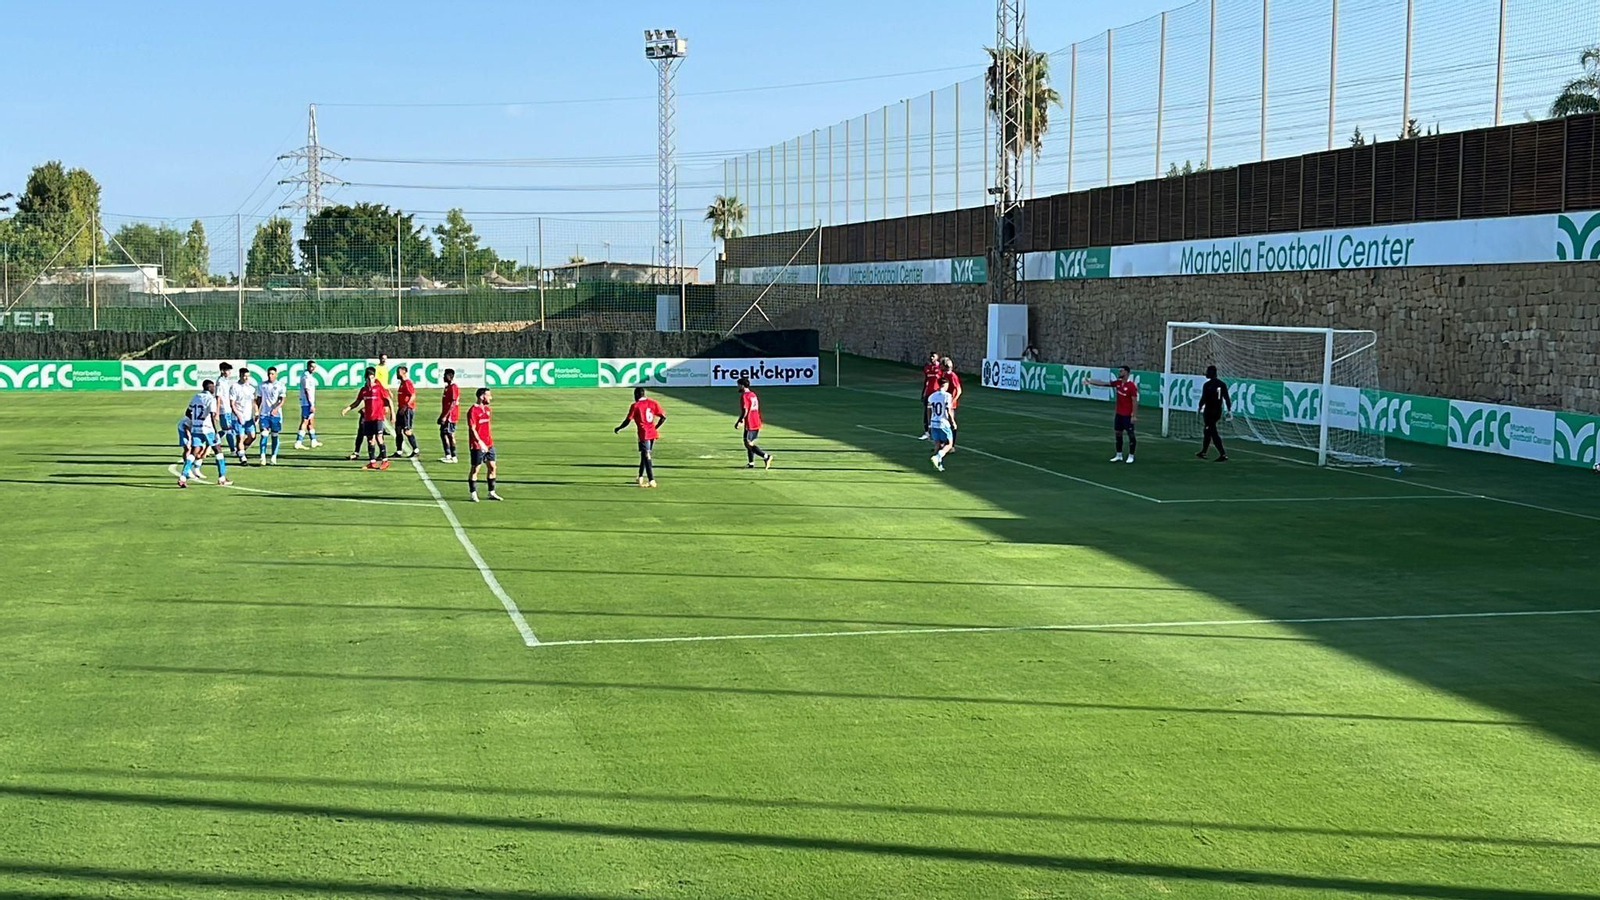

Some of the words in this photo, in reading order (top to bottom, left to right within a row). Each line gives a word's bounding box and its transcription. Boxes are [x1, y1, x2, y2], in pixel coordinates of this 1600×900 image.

[1180, 243, 1251, 274] Marbella
[1257, 234, 1332, 271] Football
[1337, 234, 1414, 268] Center
[1216, 386, 1222, 400] 1
[192, 404, 205, 421] 12
[645, 408, 654, 423] 6
[931, 401, 943, 416] 10
[1510, 423, 1535, 434] Marbella
